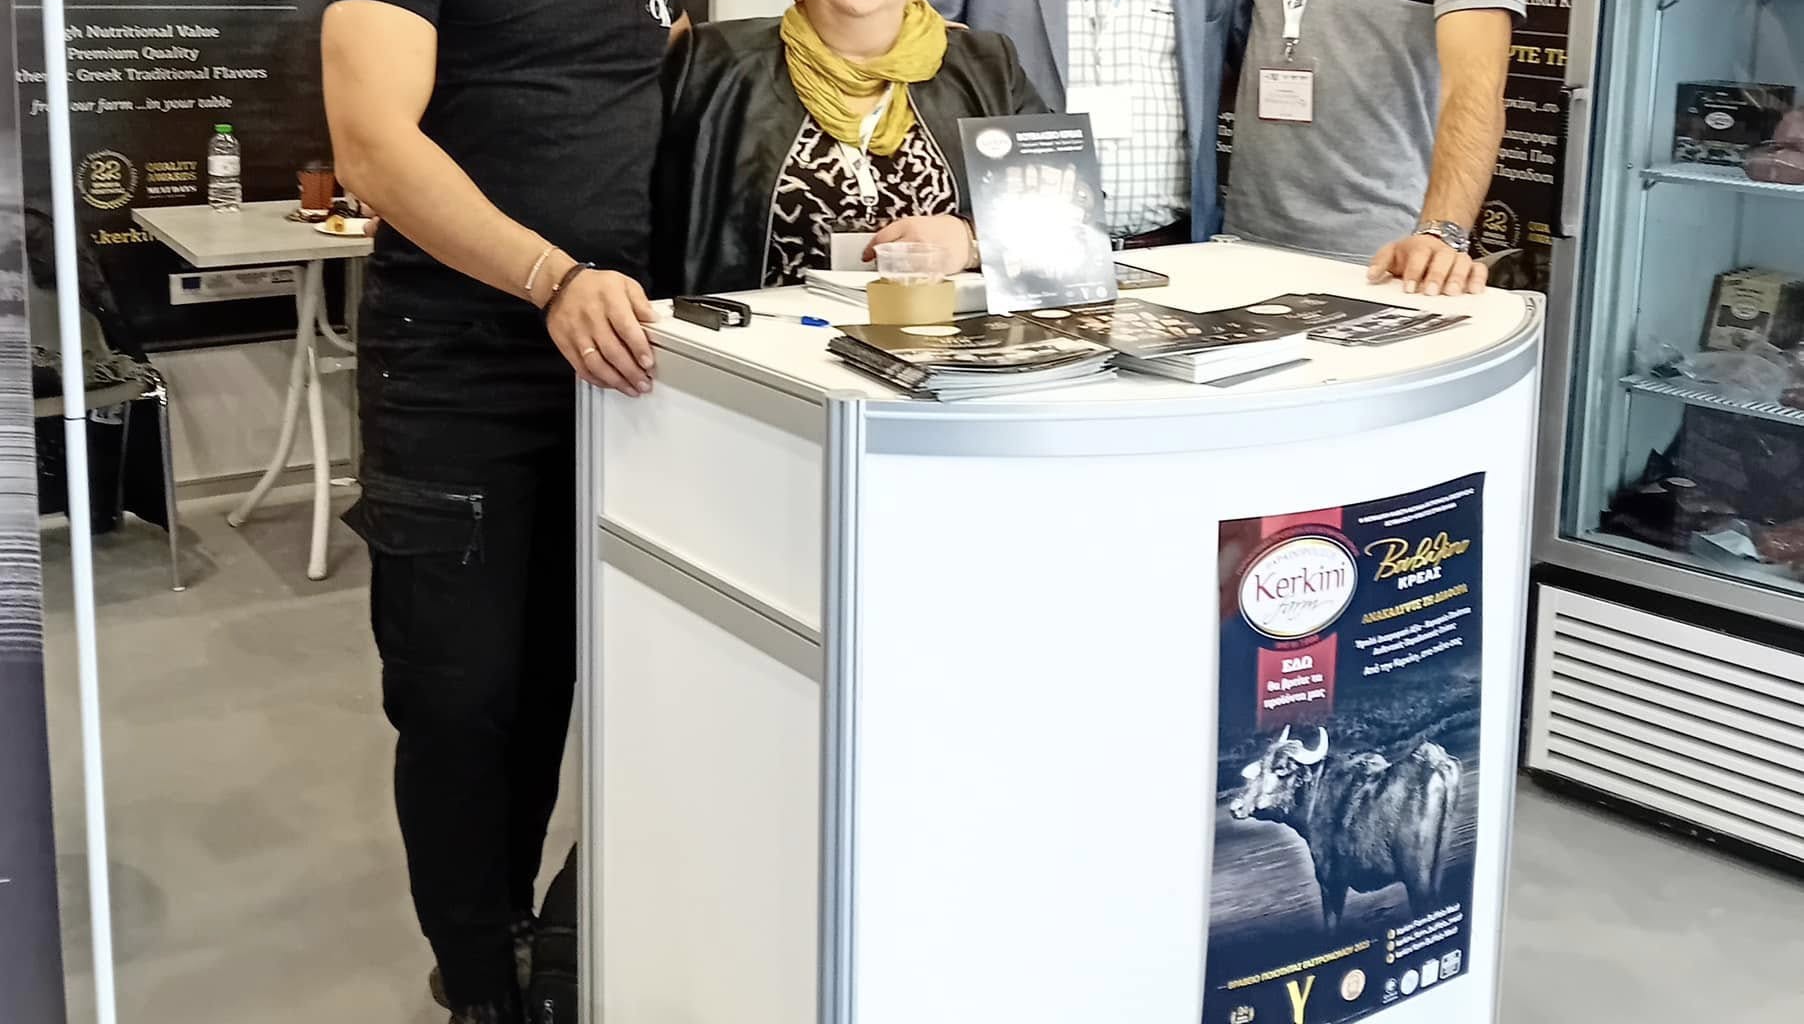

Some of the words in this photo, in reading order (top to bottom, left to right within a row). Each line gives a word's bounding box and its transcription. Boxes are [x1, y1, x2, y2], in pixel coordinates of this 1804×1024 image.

[86, 25, 174, 39] Nutritional
[177, 25, 221, 39] Value
[67, 47, 139, 61] Premium
[141, 46, 200, 62] Quality
[76, 68, 123, 82] Greek
[125, 67, 209, 81] Traditional
[212, 66, 268, 80] Flavors
[97, 98, 133, 115] farm
[160, 98, 195, 113] your
[91, 160, 121, 181] 22
[1255, 561, 1346, 603] Kerkini
[1397, 566, 1442, 590] ΚΡΕΑΣ
[1281, 656, 1312, 673] ΕΔΩ
